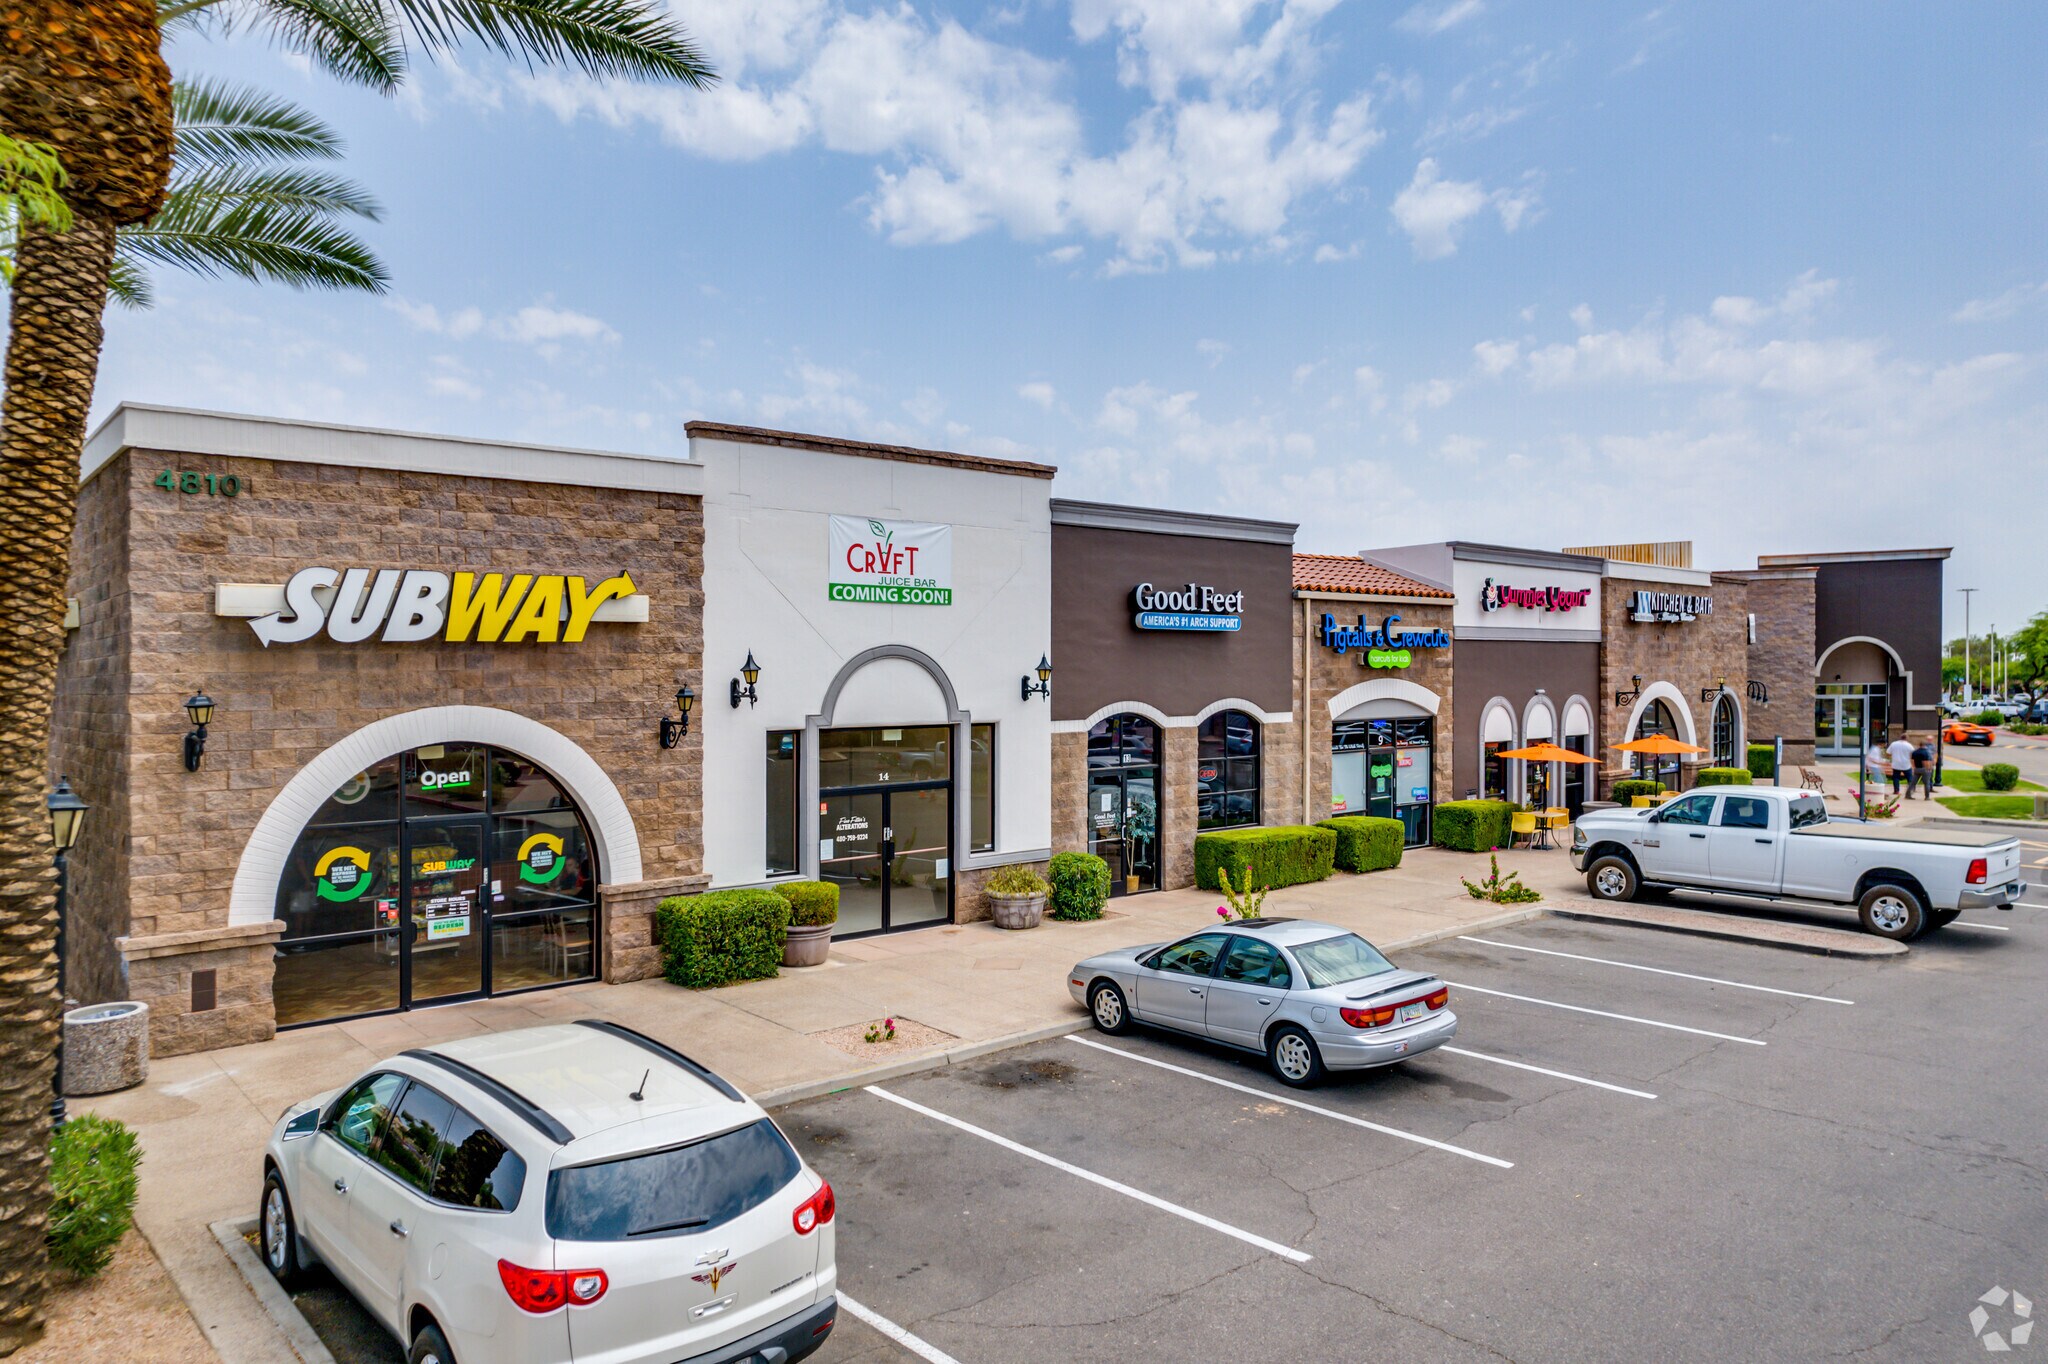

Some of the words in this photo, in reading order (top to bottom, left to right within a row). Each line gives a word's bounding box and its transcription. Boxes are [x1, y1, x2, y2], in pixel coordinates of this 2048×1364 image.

[155, 468, 241, 497] 4810
[878, 576, 911, 587] JUICE
[914, 578, 936, 588] BAR
[832, 586, 899, 603] COMING
[902, 589, 949, 604] SOON!
[1136, 582, 1197, 611] Good
[1200, 586, 1245, 613] Feet
[1549, 586, 1592, 612] Yogurt
[1651, 592, 1685, 613] KITCHEN
[1687, 595, 1694, 613] &
[1695, 596, 1713, 614] BATH
[247, 566, 638, 648] SUBWAY
[1143, 615, 1180, 627] AMERICA'S
[1181, 617, 1189, 627] #1
[1190, 617, 1209, 628] ARCH
[1209, 618, 1239, 629] SUPPORT
[1324, 612, 1373, 654] Pigtails
[1376, 630, 1384, 646] &
[1385, 615, 1451, 648] Crewcuts
[1369, 654, 1391, 663] haircuts
[1399, 655, 1409, 663] kids
[1377, 735, 1384, 746] 9
[420, 770, 471, 788] Open
[878, 772, 890, 781] 14
[836, 822, 869, 831] ALTERATIONS
[420, 858, 475, 873] SUBWAY
